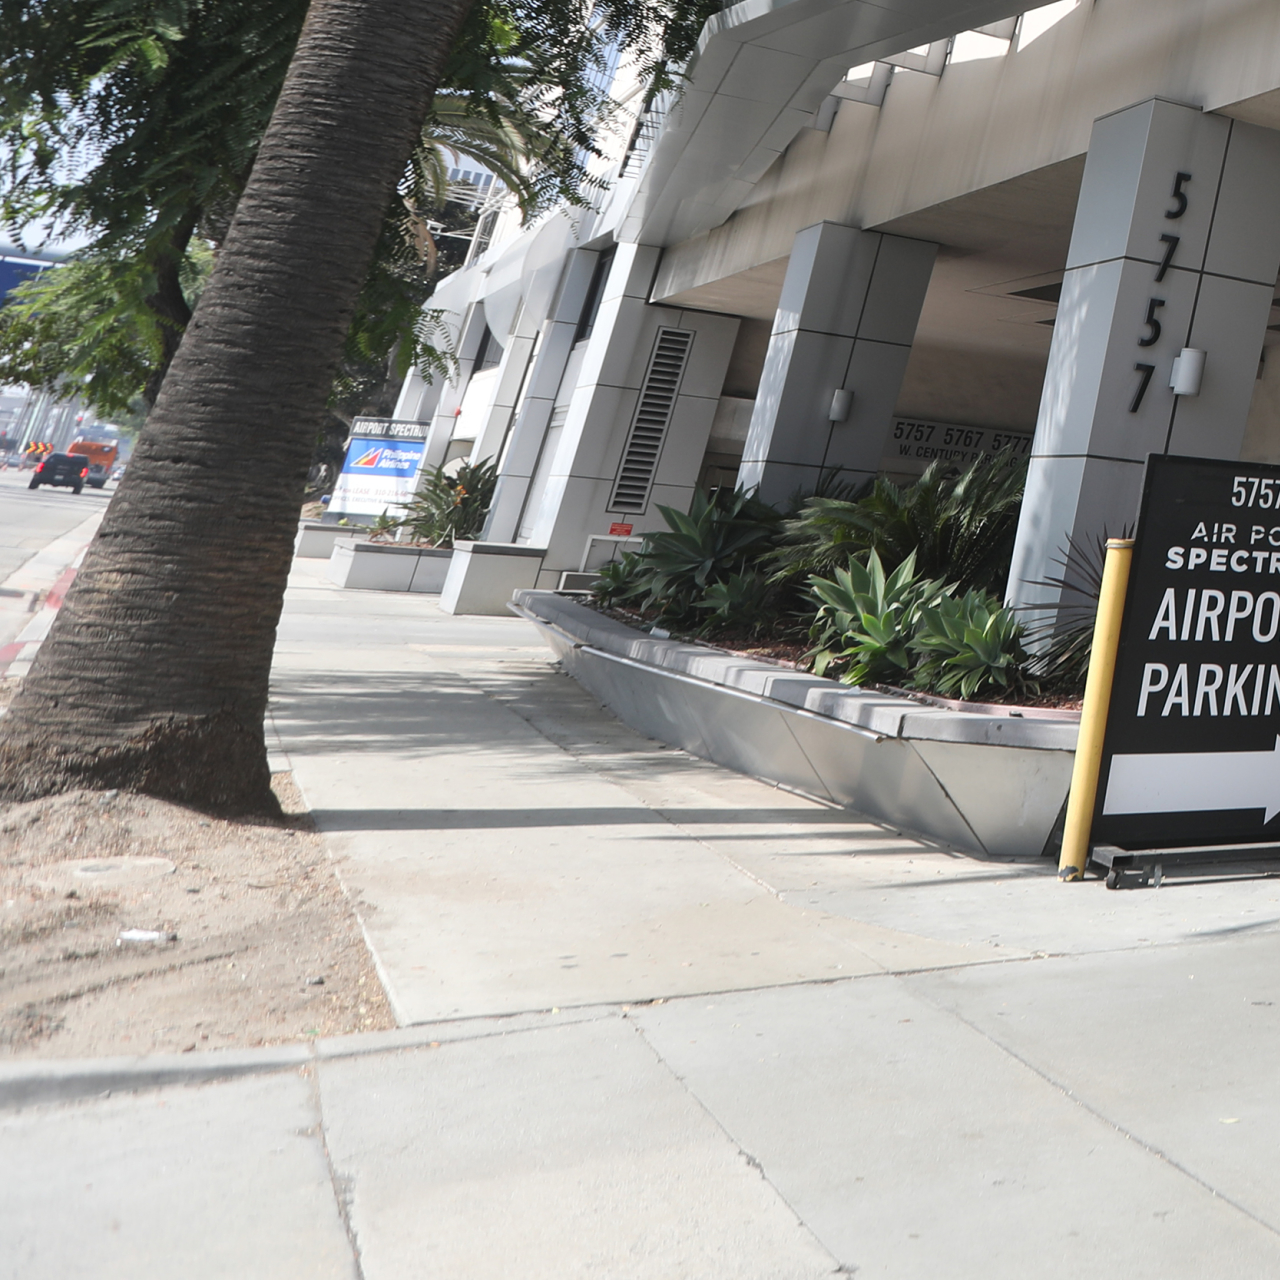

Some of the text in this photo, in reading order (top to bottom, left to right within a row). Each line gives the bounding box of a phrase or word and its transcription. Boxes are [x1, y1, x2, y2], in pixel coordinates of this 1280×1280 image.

[353, 421, 389, 435] AIRPORT
[893, 422, 1031, 454] 5757 5767 5777
[382, 449, 422, 461] Philippine
[899, 444, 912, 457] W.
[916, 446, 967, 464] CENTURY
[378, 459, 411, 470] Airlines
[1191, 522, 1236, 544] AIR
